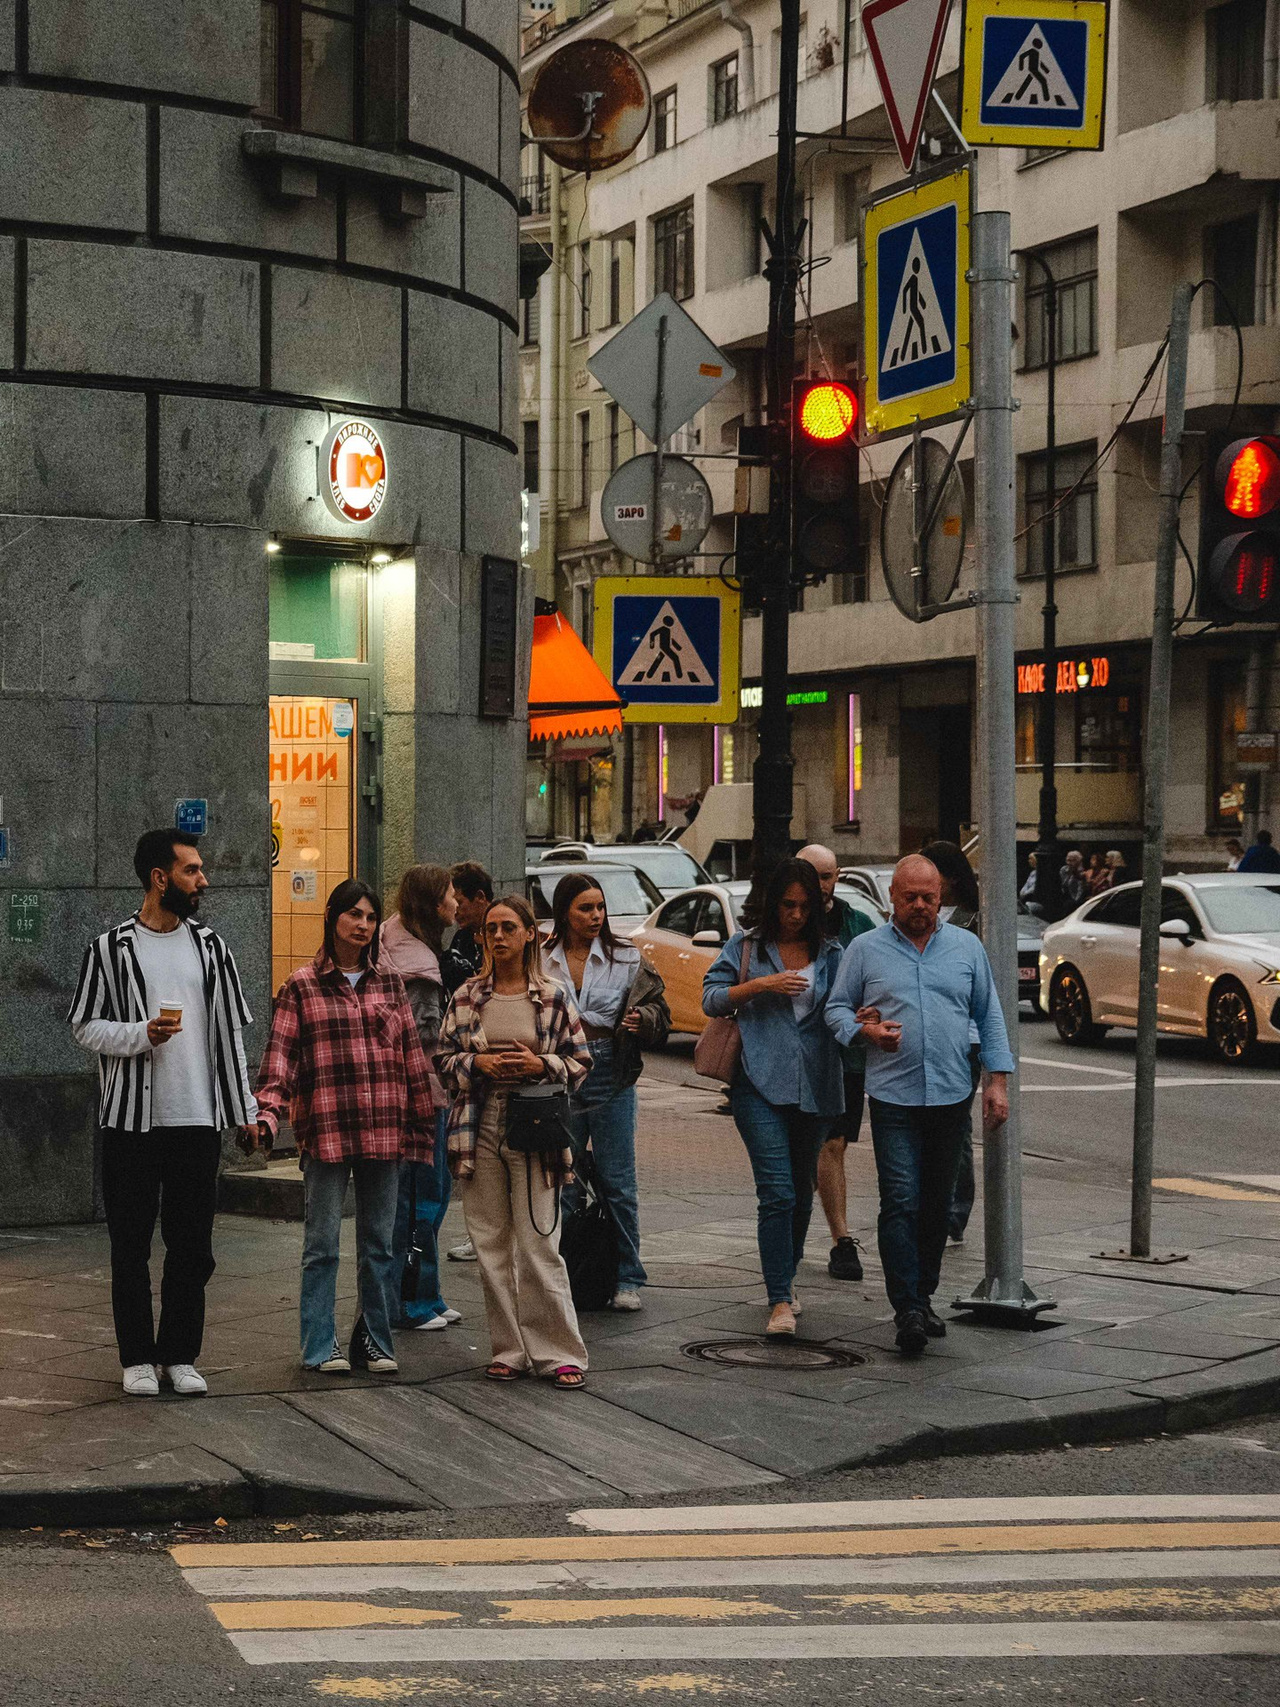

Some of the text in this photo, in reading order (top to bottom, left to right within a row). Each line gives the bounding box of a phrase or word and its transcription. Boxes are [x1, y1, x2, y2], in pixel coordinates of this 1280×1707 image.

[337, 423, 380, 450] ПИРОЖНЫЕ
[331, 479, 346, 510] ХЛЕБ
[368, 479, 386, 514] СДОБА
